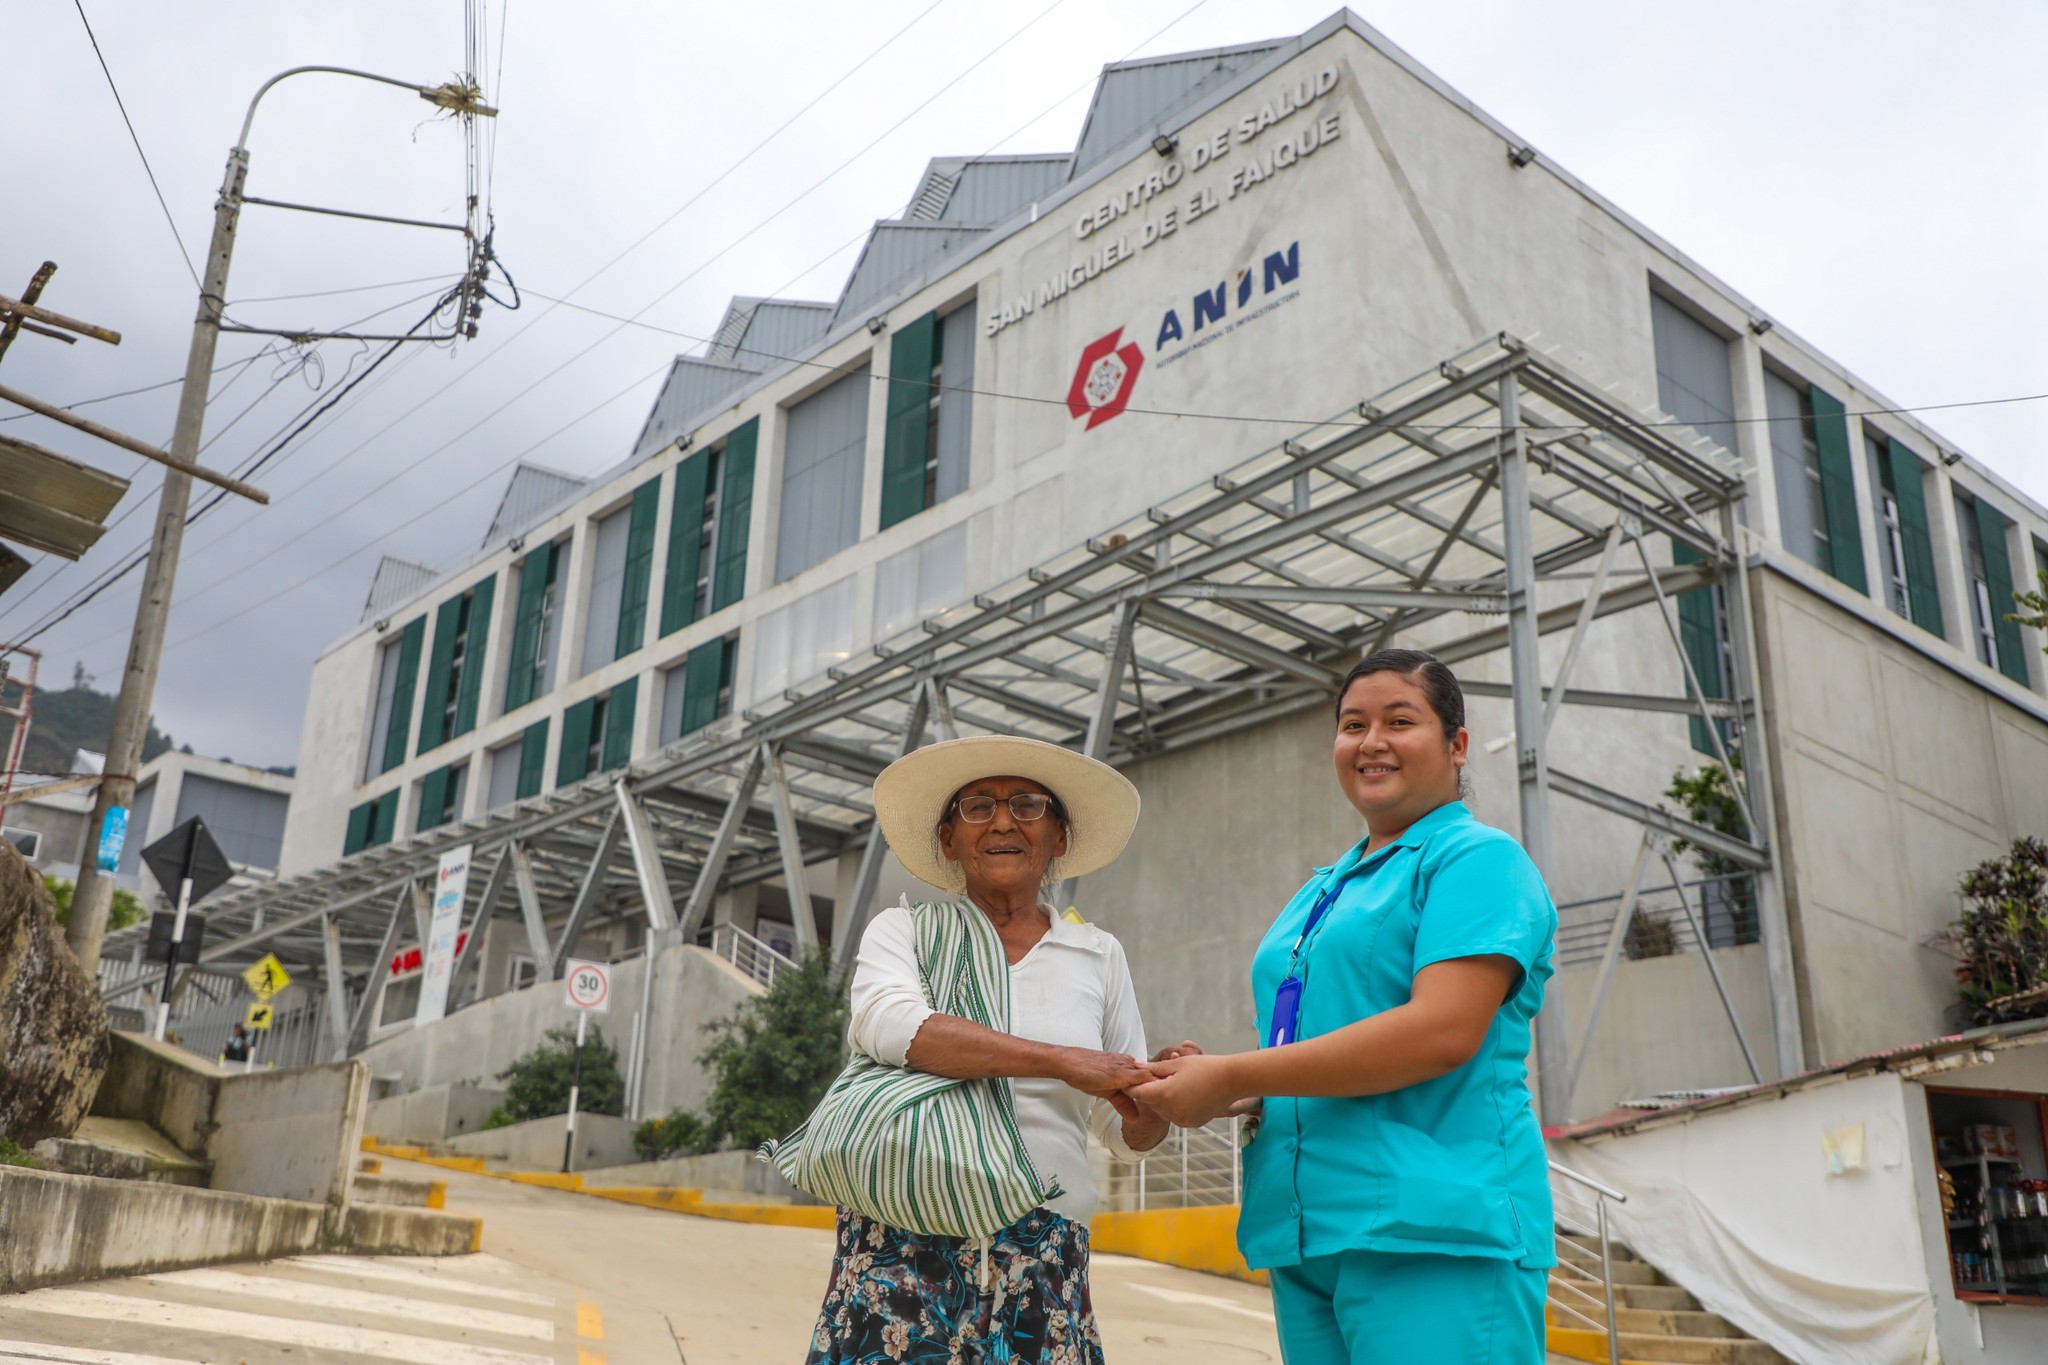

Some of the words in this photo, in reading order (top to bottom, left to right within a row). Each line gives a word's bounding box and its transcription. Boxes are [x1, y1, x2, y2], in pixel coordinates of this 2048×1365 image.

[983, 288, 1034, 338] SAN
[1040, 236, 1135, 308] MIGUEL
[1141, 206, 1178, 250] DE
[1186, 186, 1220, 225] EL
[1229, 111, 1341, 200] FAIQUE
[1075, 160, 1185, 241] CENTRO
[1192, 128, 1230, 174] DE
[1238, 64, 1340, 144] SALUD
[578, 974, 599, 991] 30
